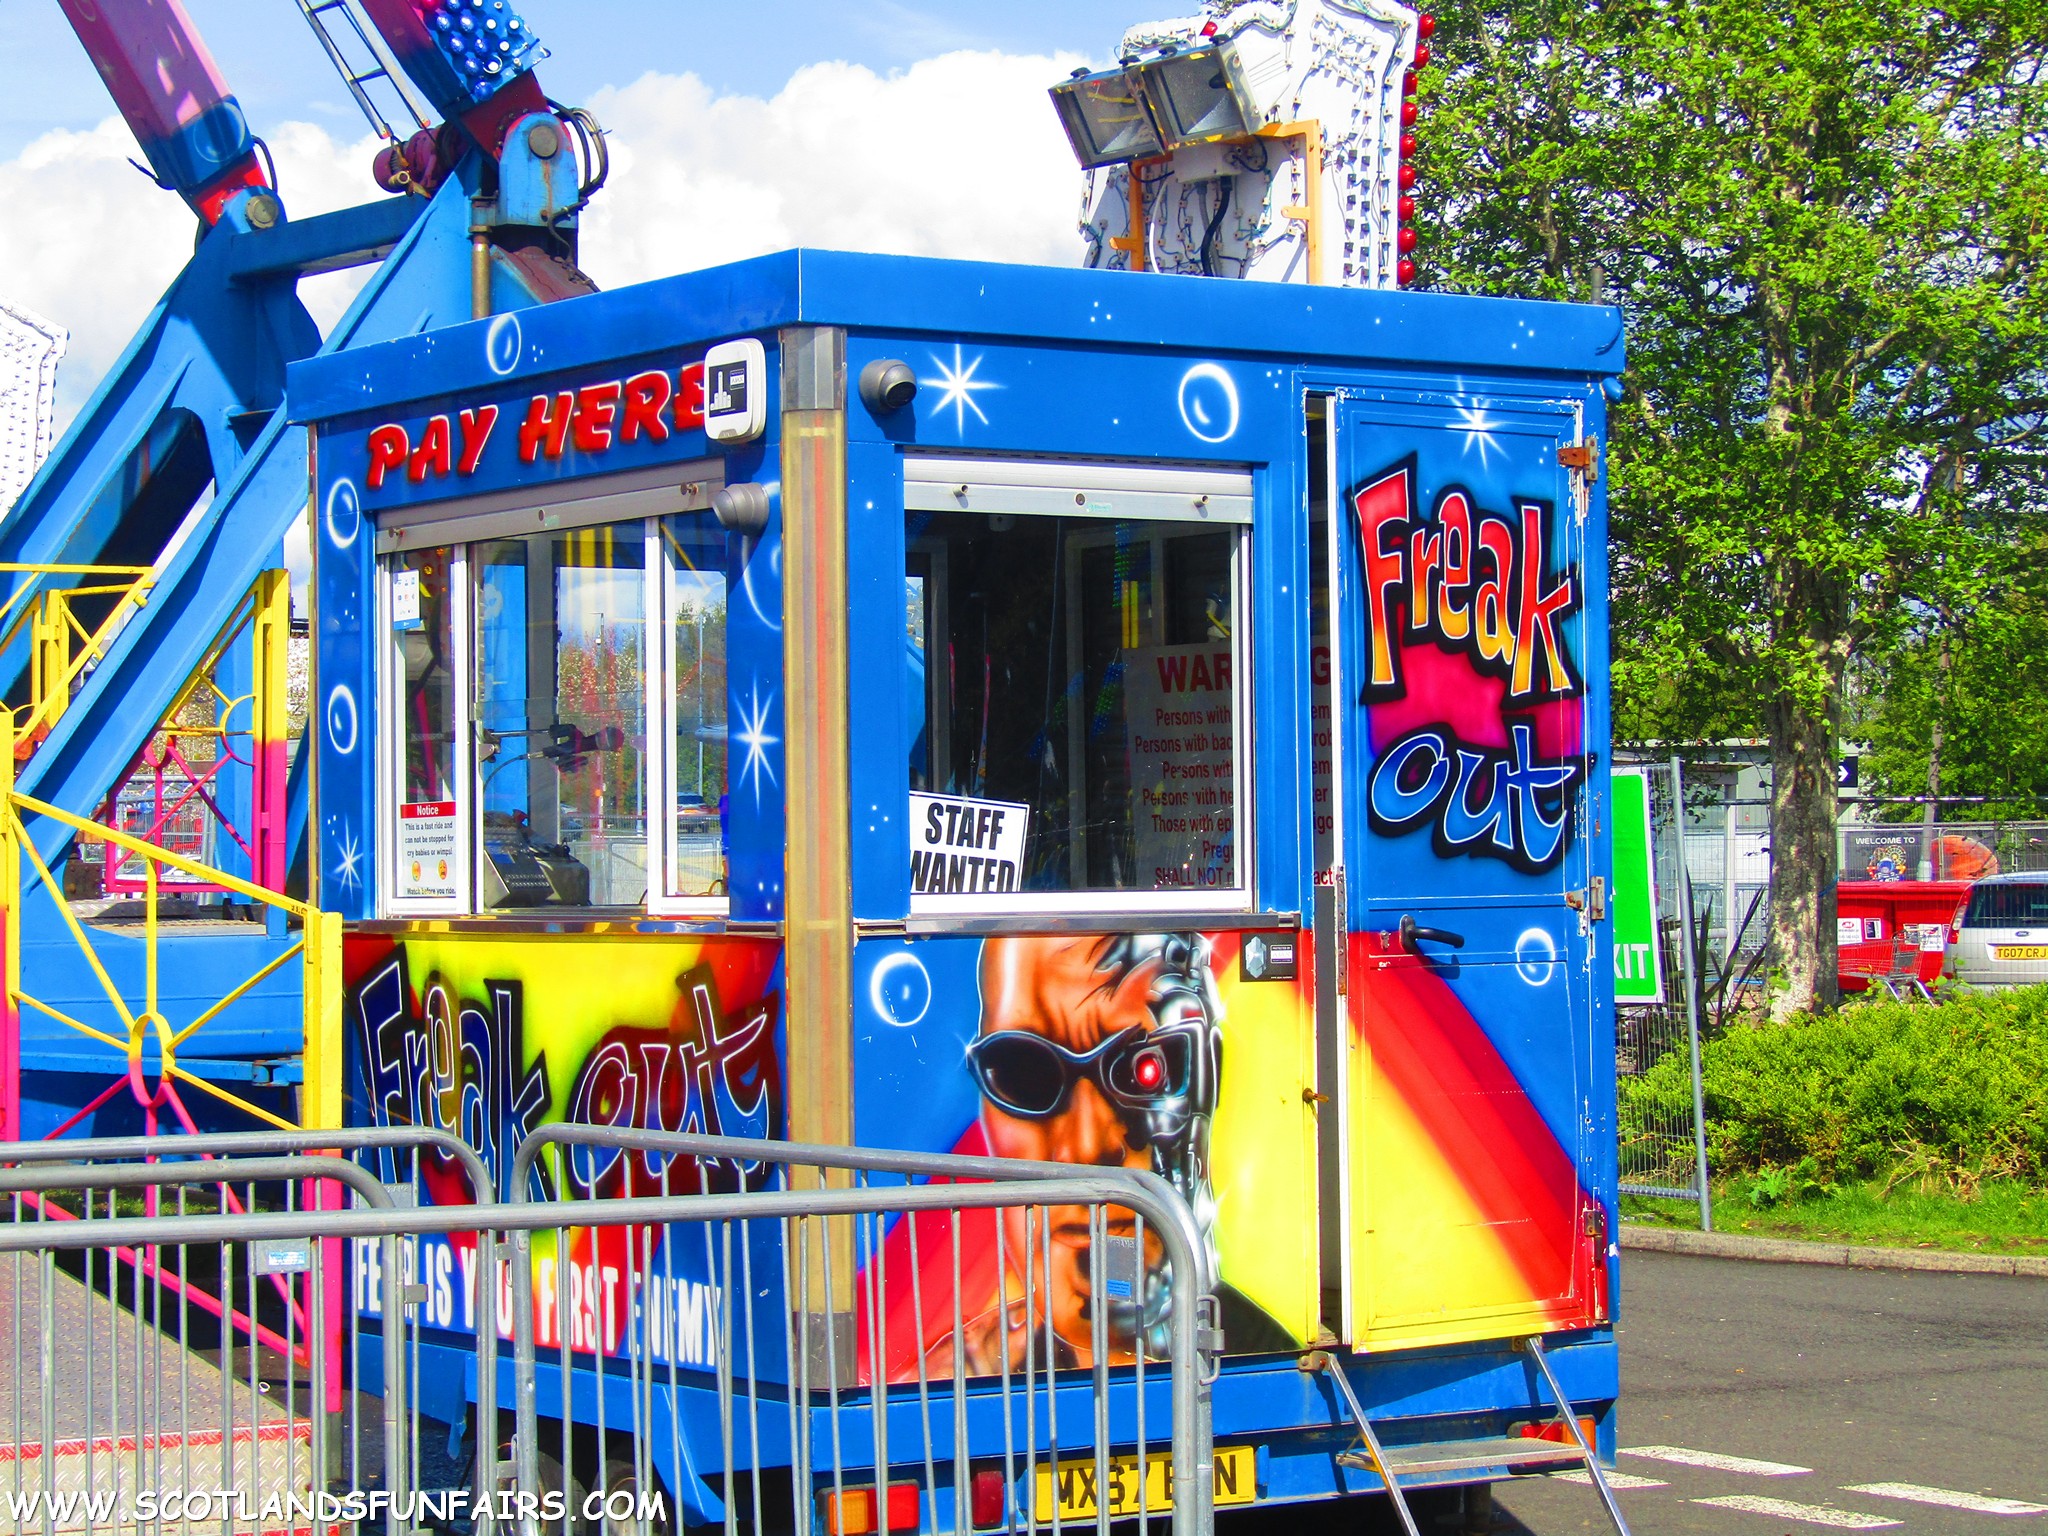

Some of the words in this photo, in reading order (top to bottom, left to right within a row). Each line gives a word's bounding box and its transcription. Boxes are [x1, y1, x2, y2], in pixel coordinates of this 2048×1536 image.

[367, 404, 498, 488] PAY
[519, 360, 705, 463] HERE
[1355, 468, 1573, 696] Freak
[1156, 707, 1204, 726] Persons
[1135, 735, 1181, 753] Persons
[1184, 733, 1209, 750] with
[1163, 760, 1208, 779] Persons
[1143, 788, 1189, 805] Persons
[1192, 787, 1217, 805] with
[416, 804, 440, 816] Notice
[405, 823, 415, 831] This
[416, 822, 421, 830] is
[434, 821, 443, 829] ride
[444, 821, 453, 829] and
[925, 802, 1005, 850] STAFF
[1152, 815, 1187, 833] Those
[1189, 814, 1214, 831] with
[429, 835, 447, 844] stopped
[1855, 837, 1902, 845] WELCOME
[1903, 836, 1916, 844] TO
[910, 850, 1016, 892] WANTED
[1155, 867, 1195, 886] SHALL
[1197, 866, 1223, 886] NOT
[1997, 948, 2023, 958] TG07
[2026, 948, 2047, 958] CRJ
[360, 960, 556, 1205] Freak
[357, 1237, 414, 1319] FER
[425, 1243, 452, 1328] IS
[461, 1246, 515, 1336] YU
